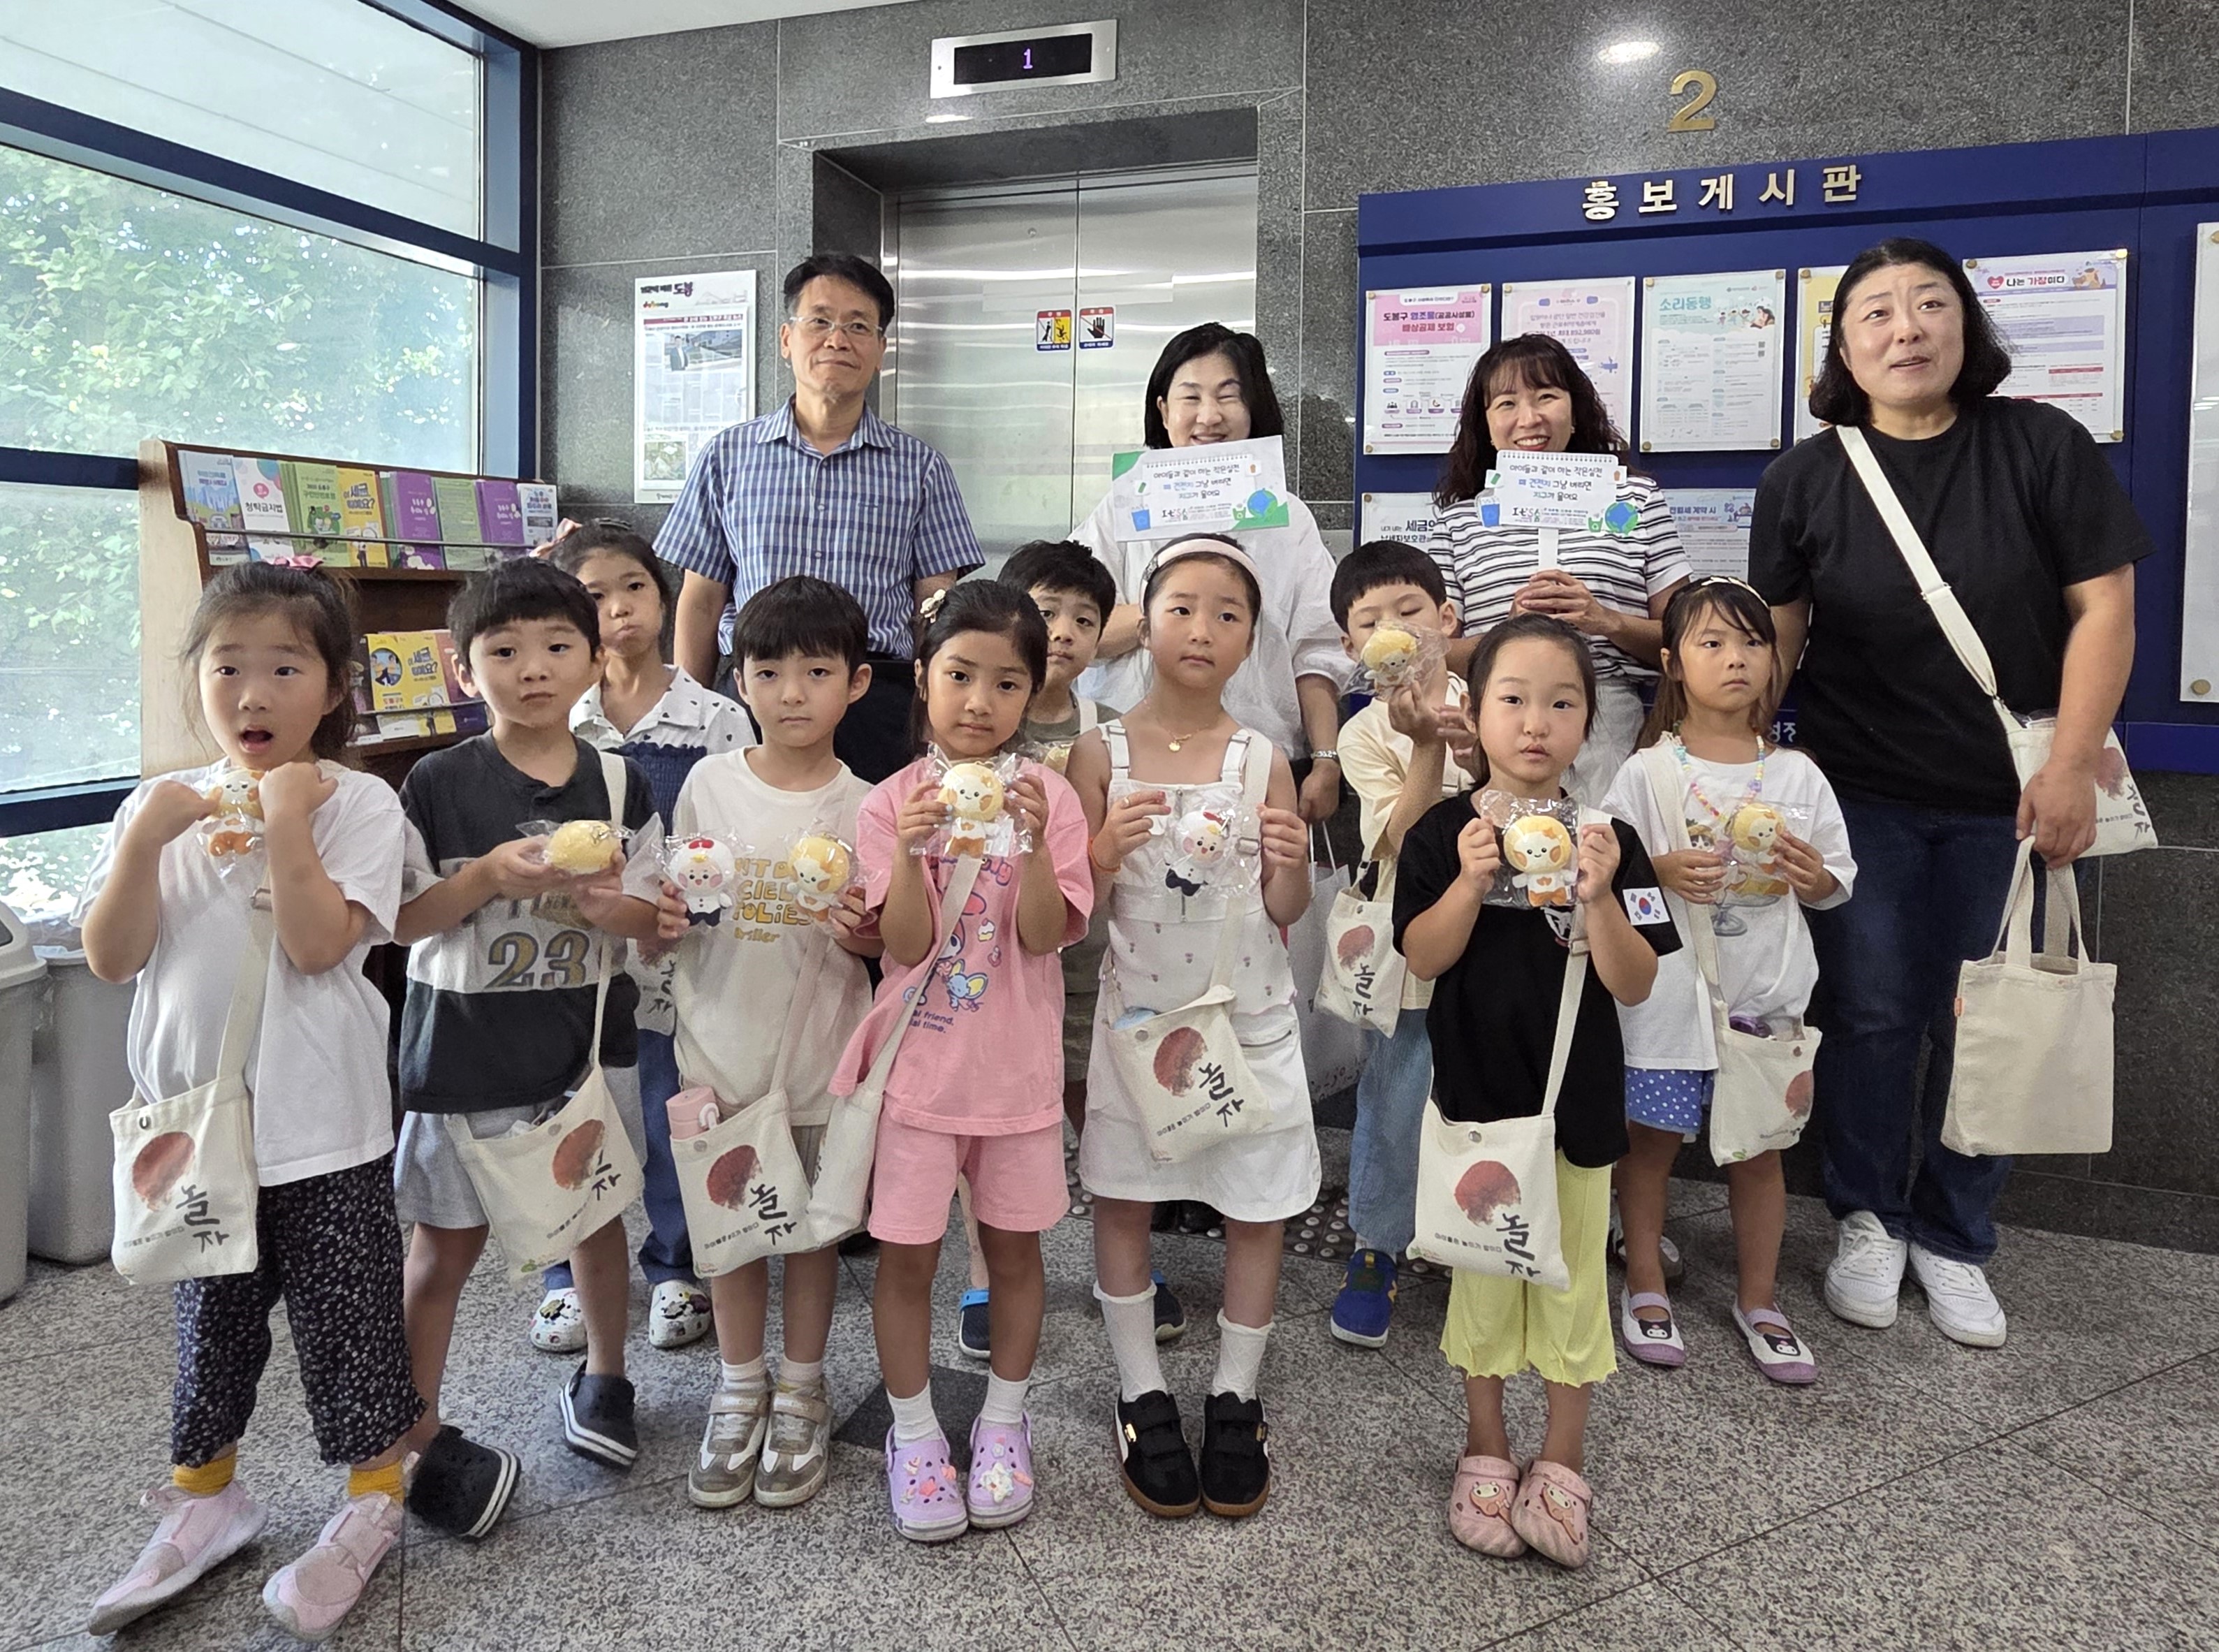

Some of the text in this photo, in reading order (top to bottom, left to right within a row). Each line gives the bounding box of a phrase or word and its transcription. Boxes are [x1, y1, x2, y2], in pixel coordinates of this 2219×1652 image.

[1023, 47, 1033, 69] 1
[1667, 70, 1718, 131] 2
[1582, 165, 1861, 221] 홍보게시판
[1660, 295, 1712, 312] 소리동행
[1383, 312, 1409, 321] 도봉구
[1153, 469, 1181, 480] 아이들과
[1198, 467, 1212, 476] 하는
[1509, 464, 1539, 474] 아이들과
[1540, 465, 1556, 474] 같이
[1557, 466, 1572, 475] 하는
[1195, 479, 1210, 489] 그냥
[1552, 479, 1569, 490] 그냥
[1569, 481, 1592, 491] 버리면
[1201, 489, 1221, 499] 울어요
[1557, 492, 1579, 502] 울어요
[245, 501, 284, 513] 청탁금지법
[1708, 506, 1717, 514] 시
[485, 930, 591, 991] 23
[1198, 1062, 1245, 1128] 놀자
[175, 1184, 230, 1253] 놀자
[748, 1183, 798, 1246] 놀자
[1495, 1212, 1541, 1278] 놀자
